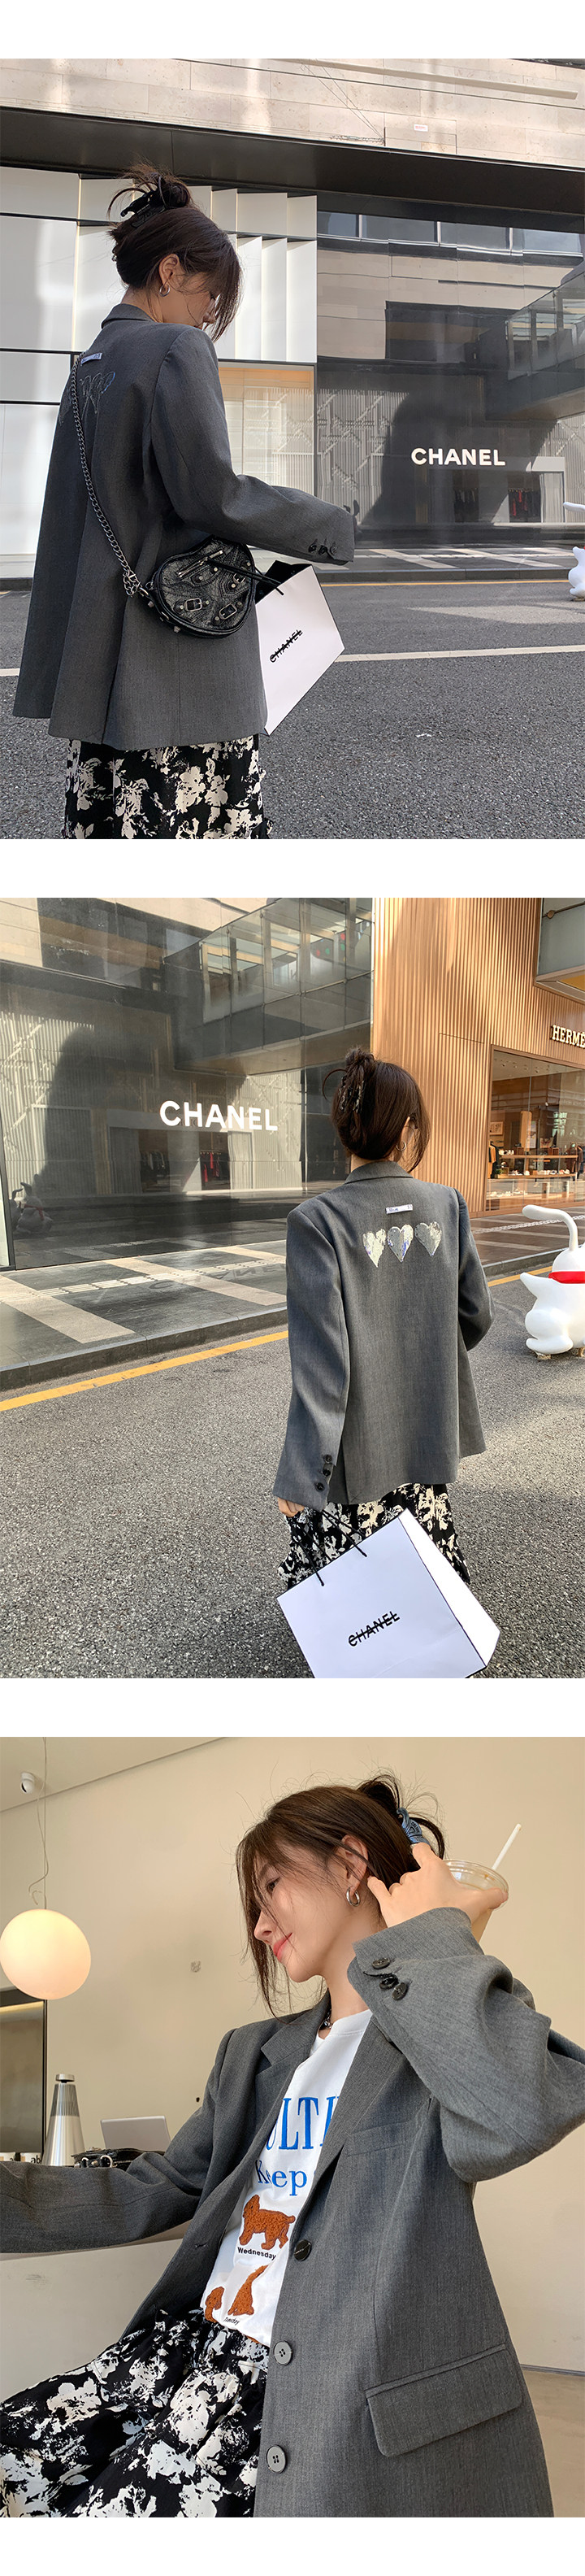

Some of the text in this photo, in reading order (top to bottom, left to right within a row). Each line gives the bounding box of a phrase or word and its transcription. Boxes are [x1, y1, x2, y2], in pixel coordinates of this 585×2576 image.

[411, 447, 506, 466] CHANEL
[270, 629, 303, 663] CHANEL
[159, 1100, 279, 1131] CHANEL
[348, 1611, 401, 1647] CHANEL
[30, 2155, 42, 2165] ab
[237, 2247, 276, 2261] Wednesday
